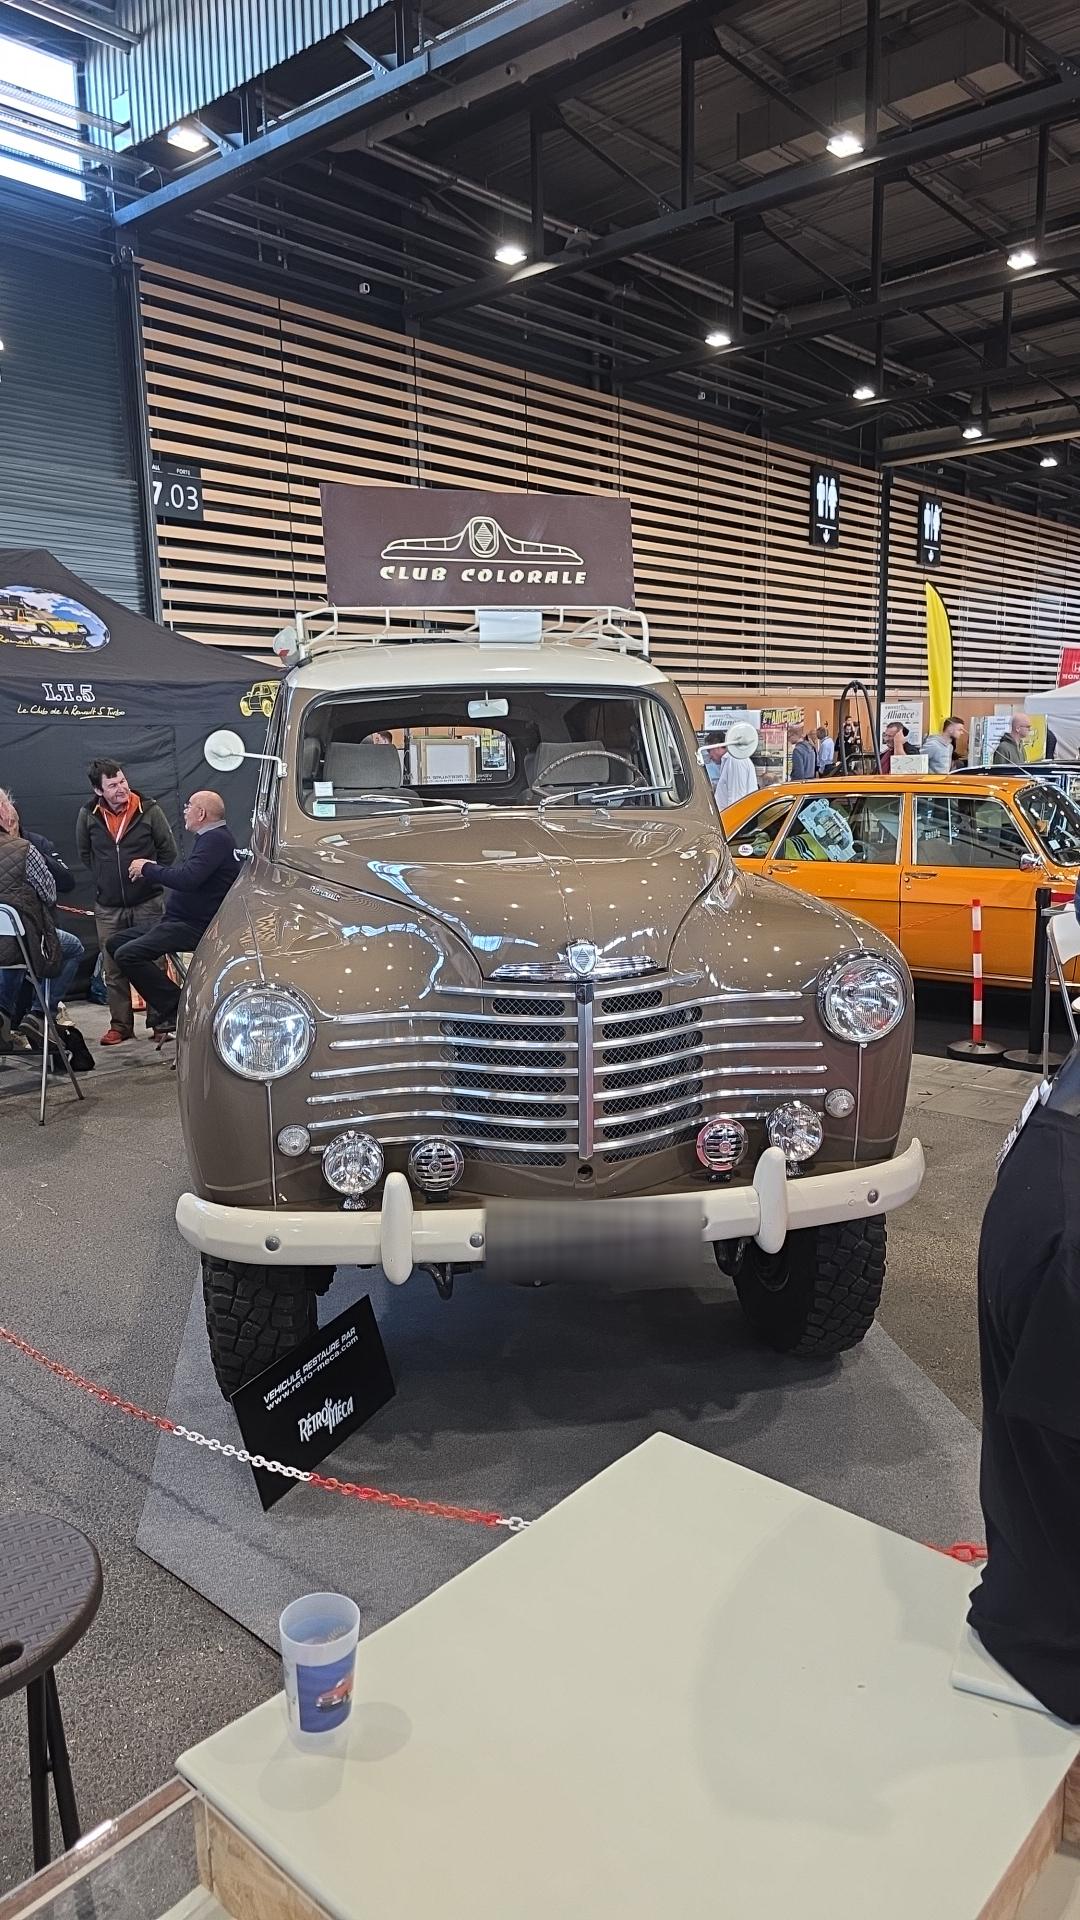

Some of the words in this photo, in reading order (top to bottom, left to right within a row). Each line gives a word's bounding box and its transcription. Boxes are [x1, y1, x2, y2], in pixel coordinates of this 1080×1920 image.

[151, 463, 161, 471] ALL
[152, 480, 199, 511] 7.03
[380, 565, 448, 581] CLUB
[461, 568, 587, 585] COLORALE
[17, 703, 29, 714] Le
[30, 704, 49, 715] Club
[50, 707, 62, 715] de
[63, 706, 70, 715] la
[70, 704, 96, 716] Renault
[97, 706, 106, 716] 5
[107, 706, 126, 716] Turbo
[883, 710, 915, 720] Alliance
[710, 718, 740, 727] Allianc
[263, 1369, 302, 1404] VEHICULE
[302, 1338, 341, 1374] RESTAURE
[341, 1326, 356, 1343] PAR
[266, 1335, 359, 1411] www.retro-meca.com
